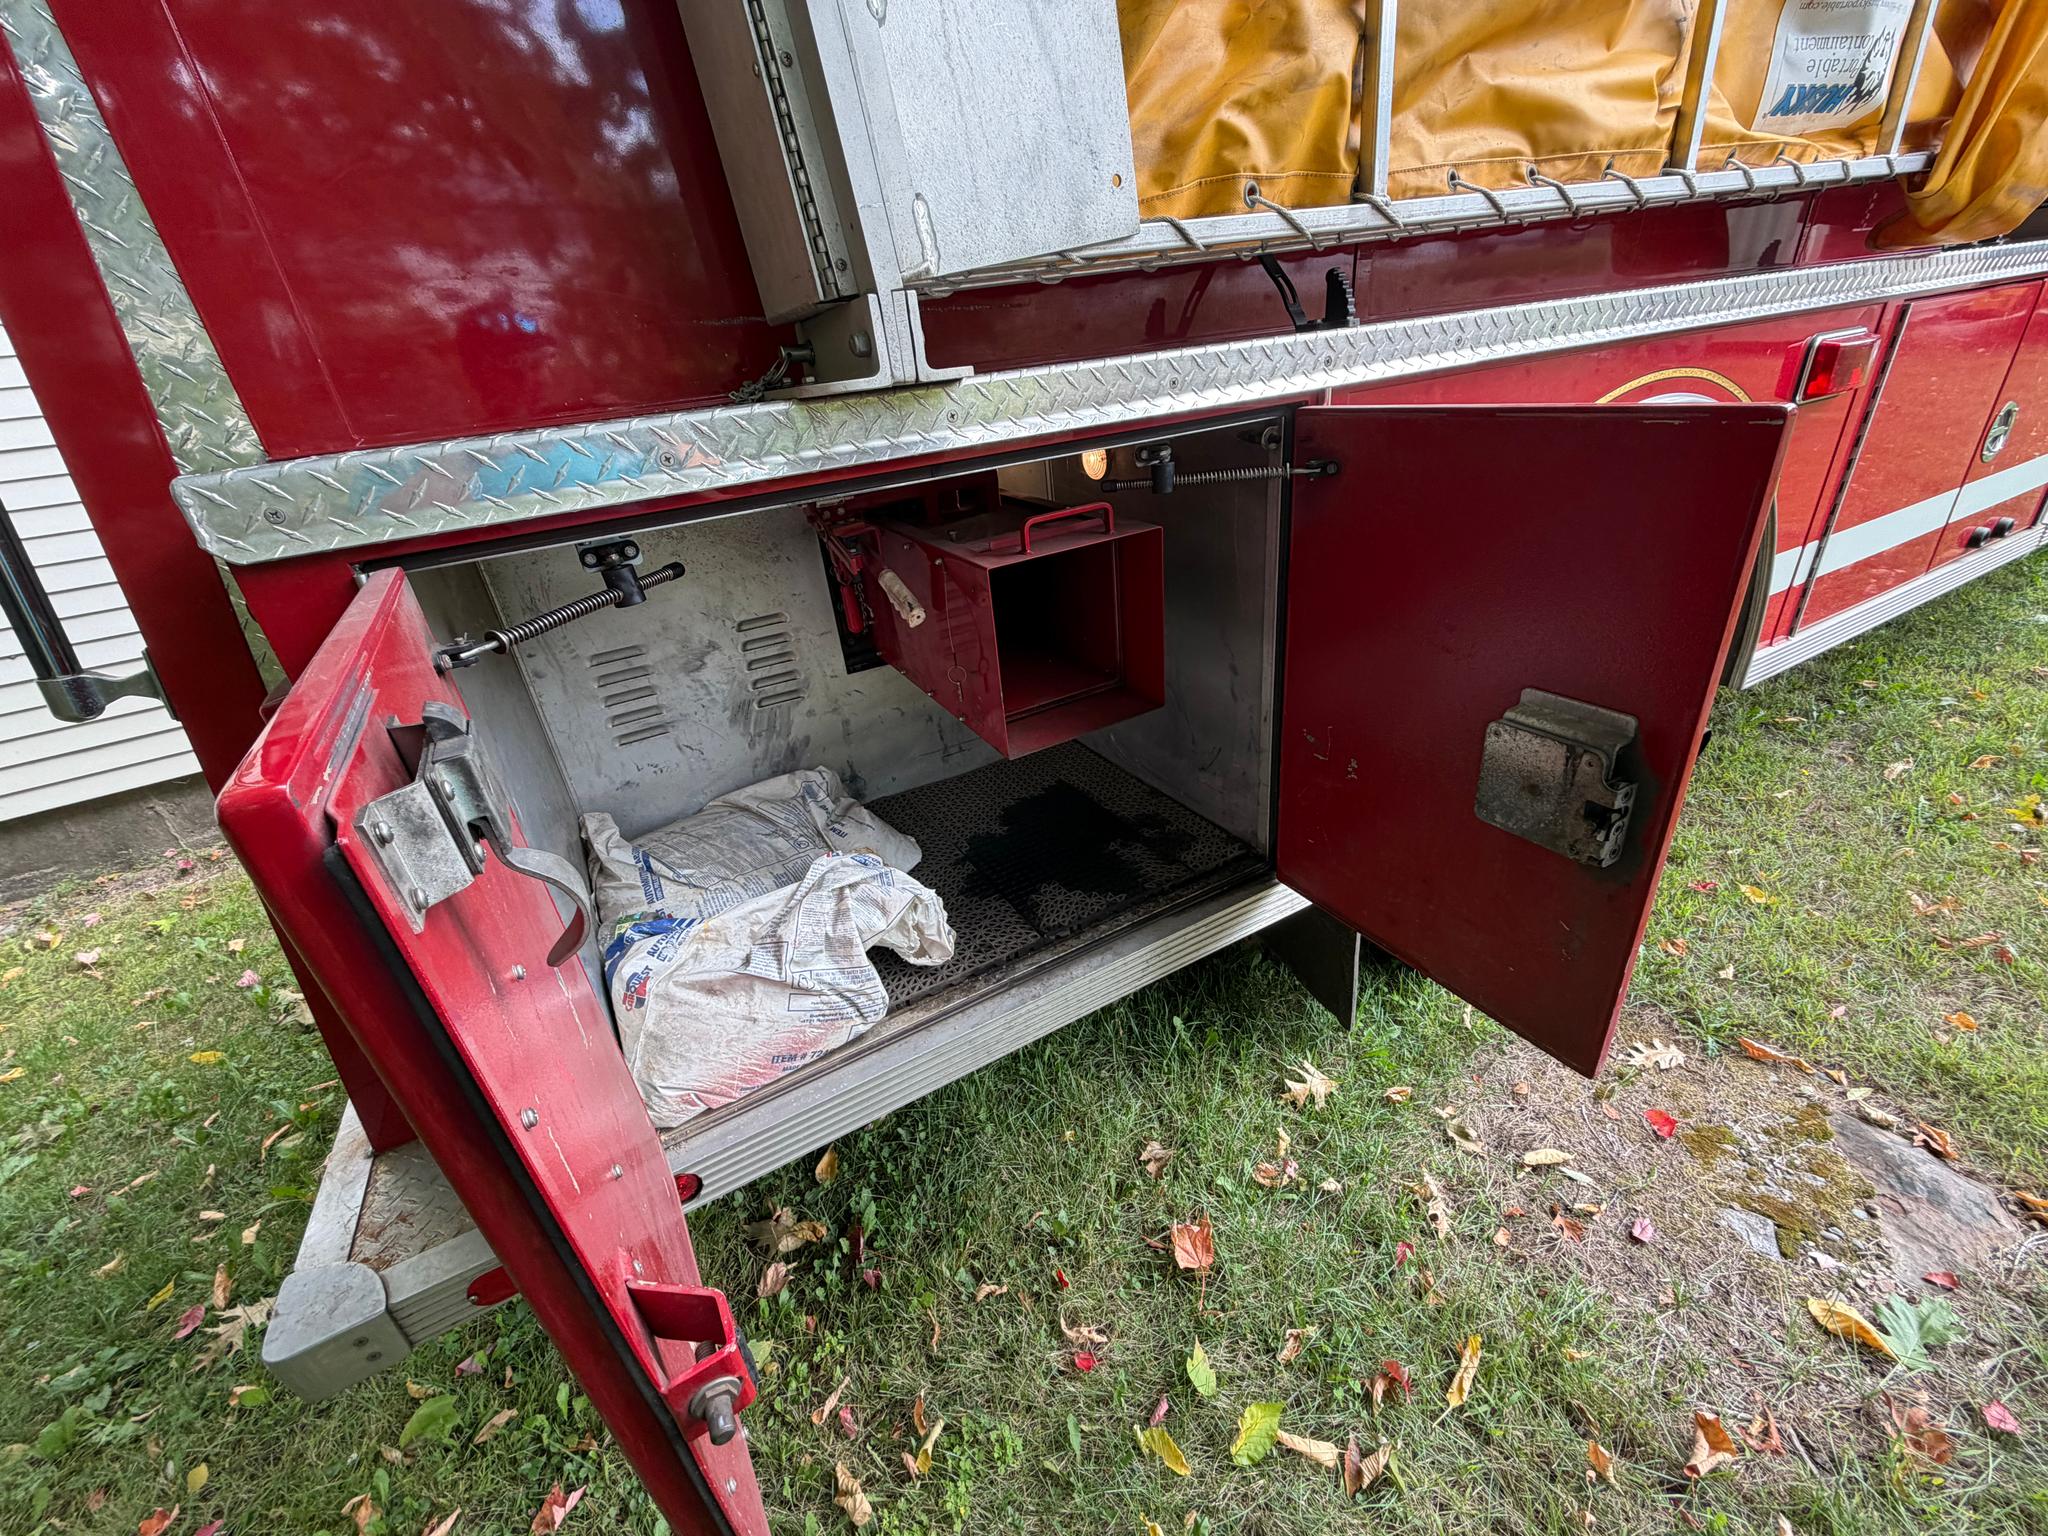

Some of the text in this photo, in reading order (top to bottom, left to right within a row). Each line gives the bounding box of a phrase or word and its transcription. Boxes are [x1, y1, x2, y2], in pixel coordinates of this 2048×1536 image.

[1794, 34, 1874, 55] Containment
[1806, 57, 1862, 78] Portable
[1769, 83, 1858, 117] HUSKY
[624, 964, 653, 1012] CARQUEST
[771, 1053, 798, 1065] ITEM
